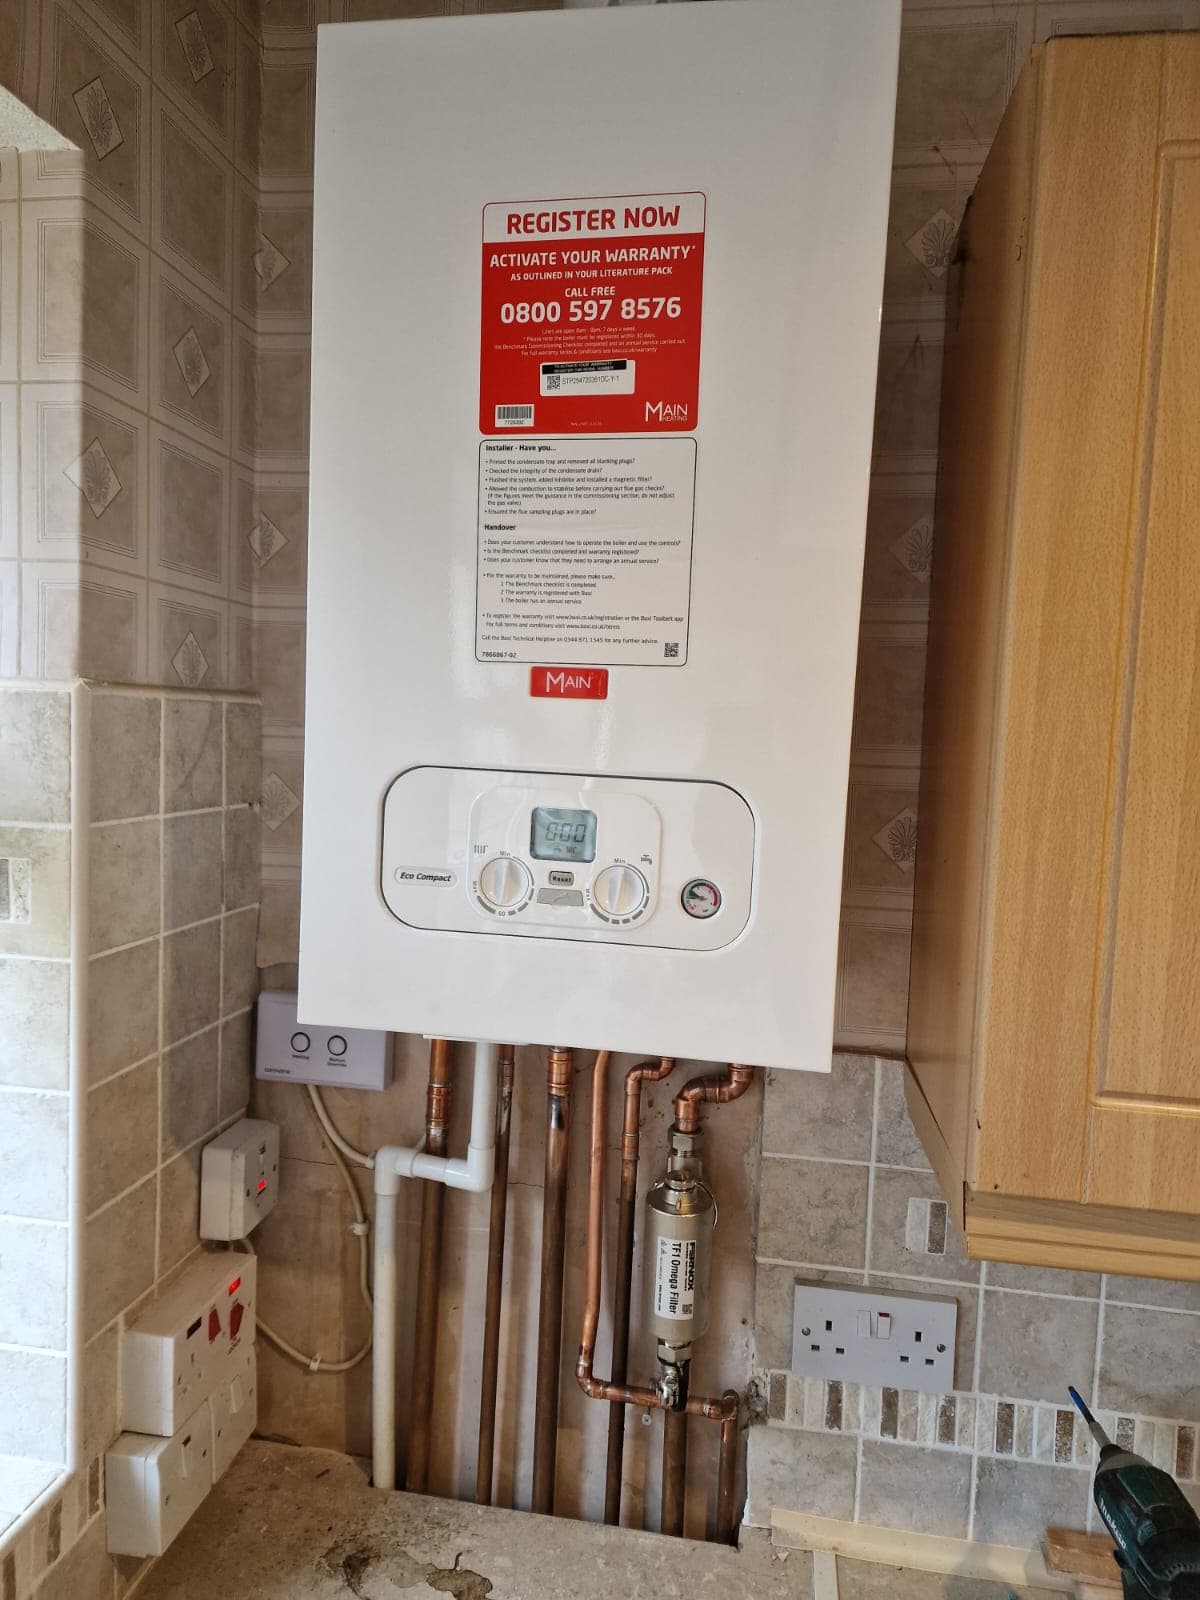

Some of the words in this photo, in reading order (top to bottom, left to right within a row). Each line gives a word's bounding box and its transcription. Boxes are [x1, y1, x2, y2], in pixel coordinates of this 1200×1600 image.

[507, 208, 615, 235] REGISTER
[623, 205, 681, 228] NOW
[489, 251, 557, 268] ACTIVATE
[561, 249, 601, 265] YOUR
[510, 273, 521, 281] AS
[523, 271, 562, 281] OUTLINED
[565, 270, 573, 279] IN
[575, 269, 597, 279] YOUR
[600, 267, 649, 278] LITERATURE
[651, 266, 673, 275] PACK
[565, 287, 588, 298] CALL
[591, 286, 616, 297] FREE
[500, 302, 561, 325] 0800
[569, 299, 613, 322] 597
[621, 296, 681, 320] 8576
[645, 401, 689, 421] MAIN
[545, 671, 592, 694] MAIN
[400, 872, 415, 881] Eco
[415, 872, 452, 884] Compact
[552, 875, 572, 883] Reset
[671, 1242, 682, 1259] TF1
[668, 1258, 681, 1289] Omega
[688, 1242, 697, 1290] FERNOX
[668, 1290, 680, 1314] Filter
